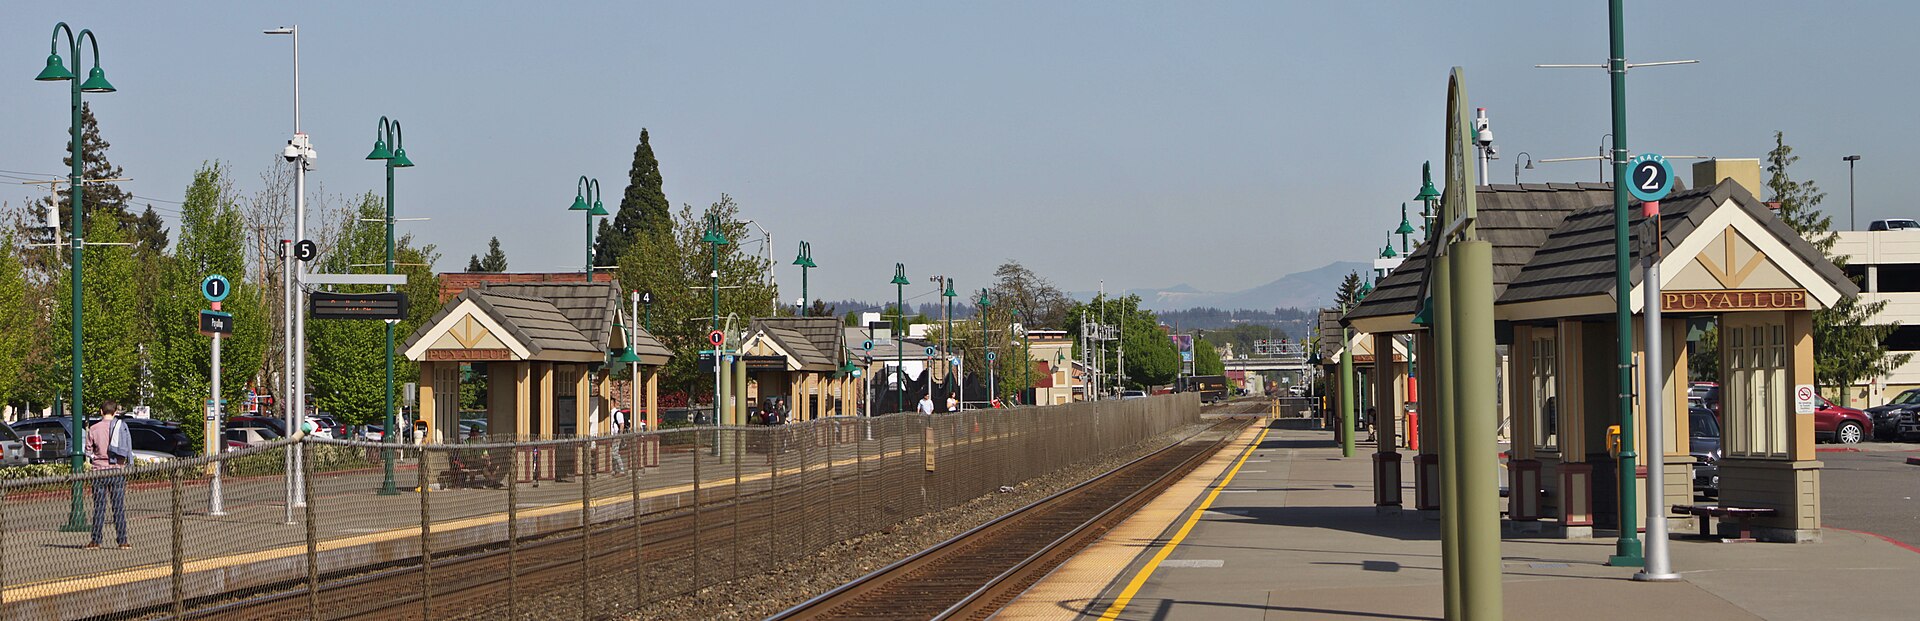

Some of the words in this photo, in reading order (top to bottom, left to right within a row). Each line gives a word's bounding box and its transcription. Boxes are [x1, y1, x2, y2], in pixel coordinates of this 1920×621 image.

[1633, 154, 1665, 165] TRACK
[1641, 165, 1659, 190] 2
[301, 243, 310, 258] 5
[212, 280, 218, 296] 1
[643, 292, 650, 303] 4
[1665, 292, 1803, 309] PUYALLUP
[714, 333, 719, 343] 1
[429, 350, 509, 360] PUYALLUP
